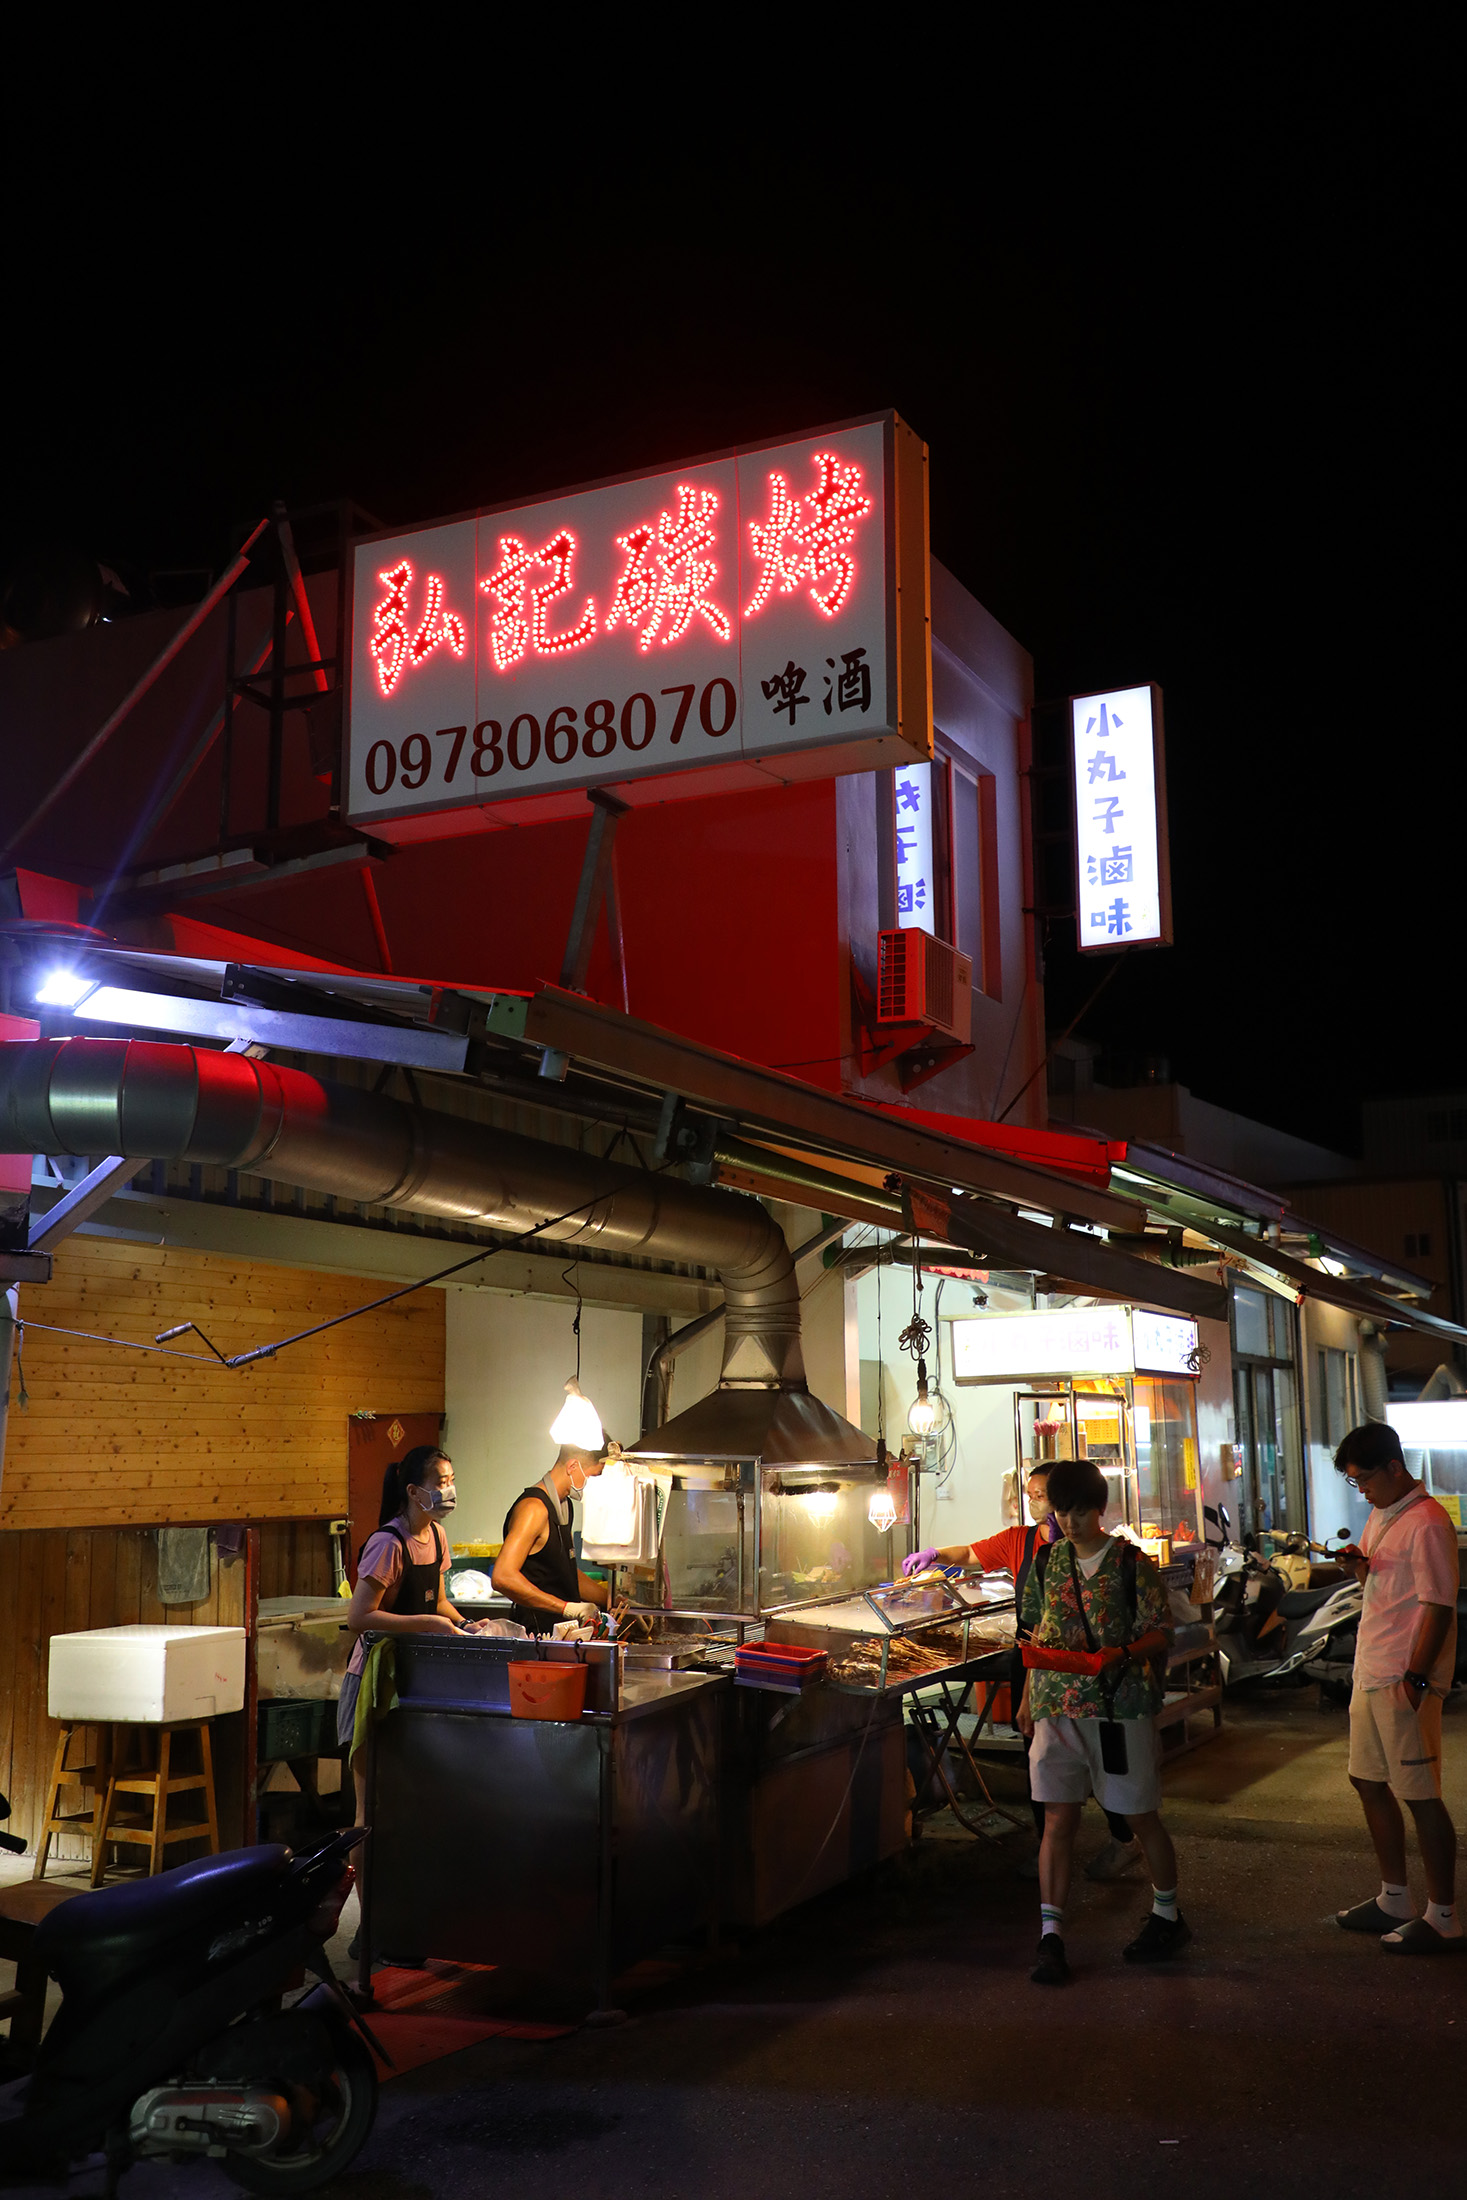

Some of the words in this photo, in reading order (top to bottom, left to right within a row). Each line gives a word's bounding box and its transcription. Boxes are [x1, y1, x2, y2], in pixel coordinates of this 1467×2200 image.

[369, 451, 872, 697] 弘記碳烤
[364, 677, 738, 796] 0978068070
[760, 647, 872, 726] 啤酒
[1085, 702, 1134, 936] 小丸子滷味
